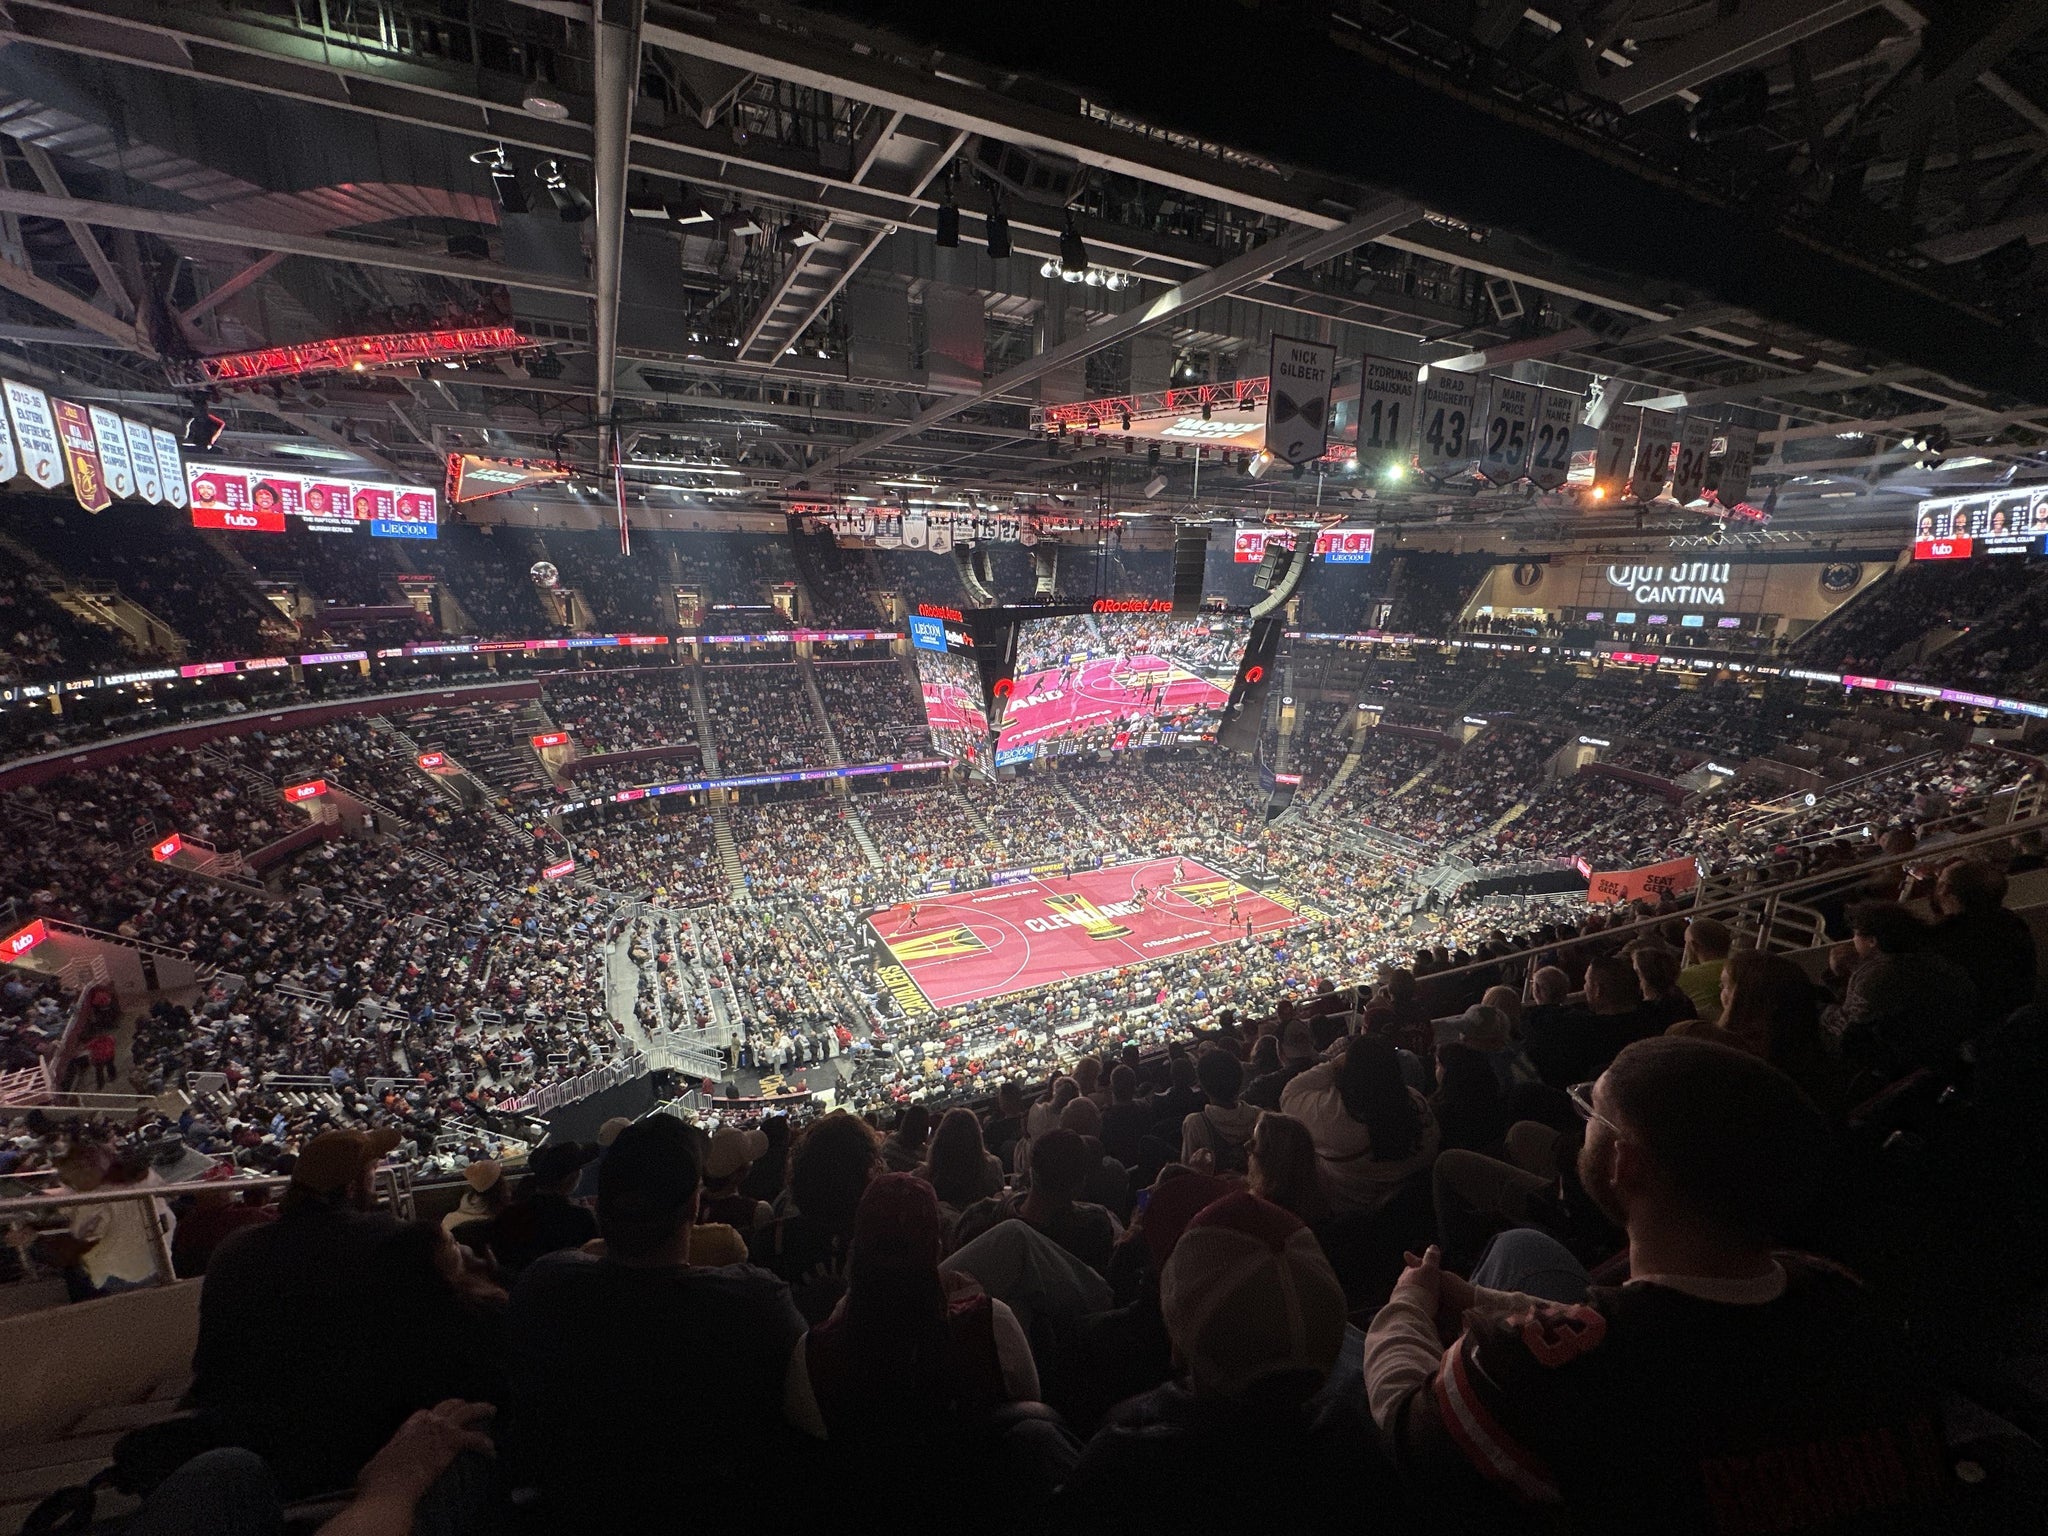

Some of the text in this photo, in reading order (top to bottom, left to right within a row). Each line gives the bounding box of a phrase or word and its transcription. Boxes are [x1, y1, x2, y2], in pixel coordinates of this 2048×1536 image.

[1292, 348, 1317, 365] NICK
[1280, 362, 1325, 381] GILBERT
[1368, 364, 1414, 382] ZYDRUNAS
[1367, 379, 1412, 396] ILGAUSKAS
[1440, 377, 1464, 390] BRAD
[1427, 389, 1472, 406] DAUGHERTY
[1502, 388, 1526, 401] MARK
[1501, 401, 1524, 416] PRICE
[1548, 395, 1572, 410] LARRY
[1546, 409, 1571, 423] NANCE
[19, 422, 53, 440] ONFERENCE
[1367, 400, 1400, 449] 11
[1426, 408, 1465, 458] 43
[1489, 416, 1525, 466] 25
[1535, 424, 1570, 470] 22
[1609, 437, 1624, 476] 7
[1638, 443, 1667, 483] 42
[1678, 449, 1704, 487] 34
[224, 513, 258, 527] fubo
[381, 523, 428, 535] LECOM
[1932, 544, 1952, 556] fubo
[1636, 585, 1726, 605] CANTINA
[923, 603, 963, 623] Rocket Arena
[1106, 599, 1173, 612] Rocket Are
[914, 623, 941, 637] LECOM
[733, 635, 746, 643] Link
[23, 684, 56, 698] TOL 4
[66, 679, 95, 690] 8:27 PM
[1022, 709, 1112, 737] Rocket Arena
[543, 736, 559, 744] fubo
[997, 746, 1035, 761] LECOM
[806, 771, 826, 779] Crucial
[297, 786, 316, 797] fubo
[666, 784, 687, 793] Crucial
[161, 843, 174, 855] fubo
[552, 862, 574, 877] Rocket
[1001, 862, 1064, 880] PHANTOM FIREWORKS
[1600, 879, 1620, 888] SEAT
[1646, 875, 1675, 886] SEAT
[983, 889, 1039, 902] Rocket Arena
[1598, 885, 1619, 896] GEEK
[1260, 889, 1333, 921] CAVAERS
[1024, 899, 1144, 933] CLEVELAND
[12, 934, 33, 953] fubo
[1151, 930, 1211, 947] Rocket Arena
[877, 965, 932, 1016] CAVALIERS
